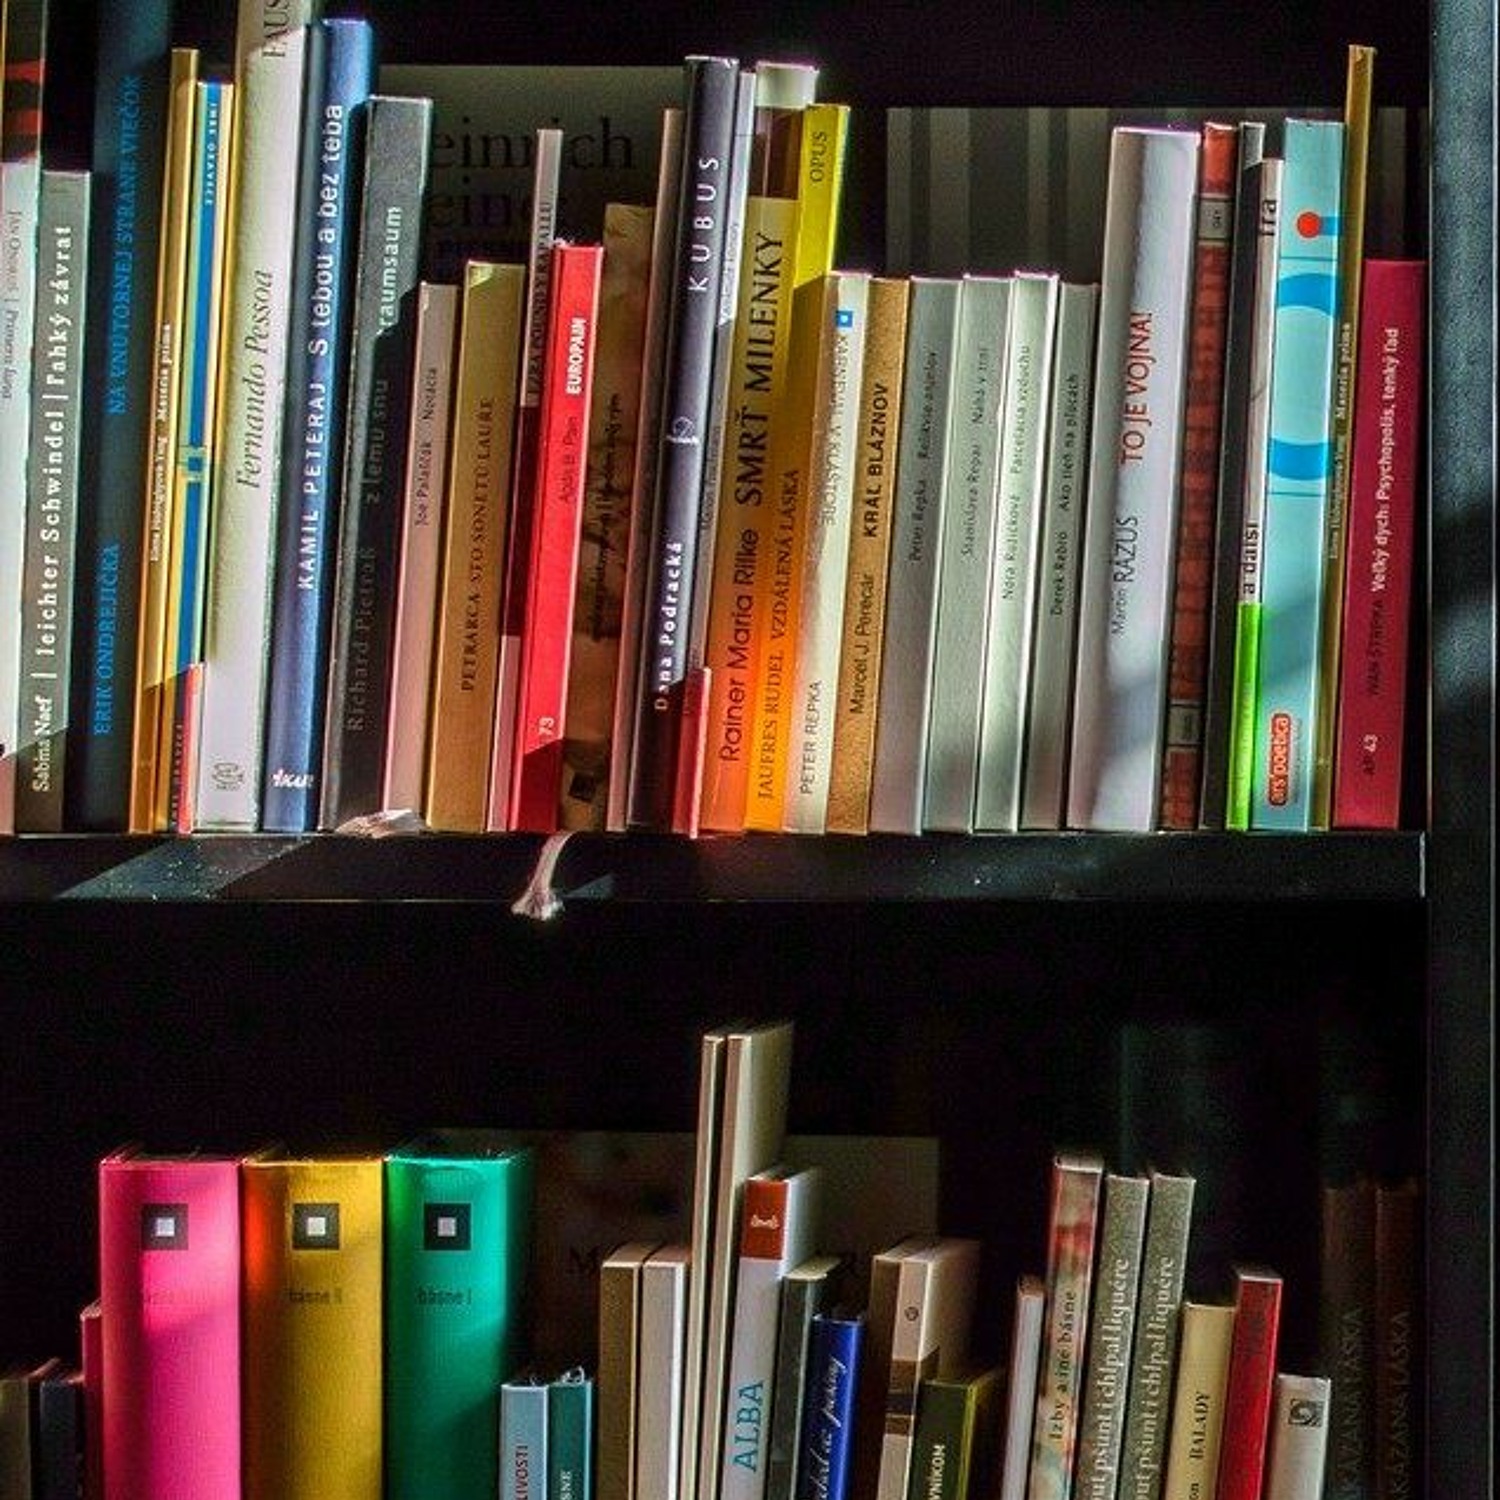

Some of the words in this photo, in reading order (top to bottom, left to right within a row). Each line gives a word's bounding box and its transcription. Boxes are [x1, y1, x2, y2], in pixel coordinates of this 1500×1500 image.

[321, 103, 344, 161] teba
[810, 130, 827, 182] OPUS
[317, 172, 340, 219] bez
[689, 157, 719, 292] KUBUS
[324, 227, 336, 245] a
[244, 269, 274, 357] Pessoa
[309, 252, 335, 332] tebou
[745, 232, 782, 392] MILENKY
[308, 338, 327, 356] S
[1128, 312, 1157, 396] VOJNA!
[237, 365, 269, 490] Fernando
[303, 381, 327, 496] PETERAJ
[1121, 429, 1145, 465] TO
[1124, 400, 1151, 427] JE
[40, 406, 68, 542] Schwindel
[735, 404, 767, 507] SMRŤ
[298, 511, 318, 589] KAMIL
[735, 528, 759, 590] Rilke
[1113, 515, 1138, 583] RÁZUS
[36, 554, 60, 656] leichter
[660, 542, 682, 645] Podracká
[727, 594, 752, 673] Maria
[720, 678, 747, 762] Rainer
[764, 649, 784, 713] RUDEL
[804, 679, 824, 735] REPKA
[801, 740, 816, 796] PETER
[734, 1381, 764, 1473] ALBA
[1190, 1393, 1211, 1460] BALADY
